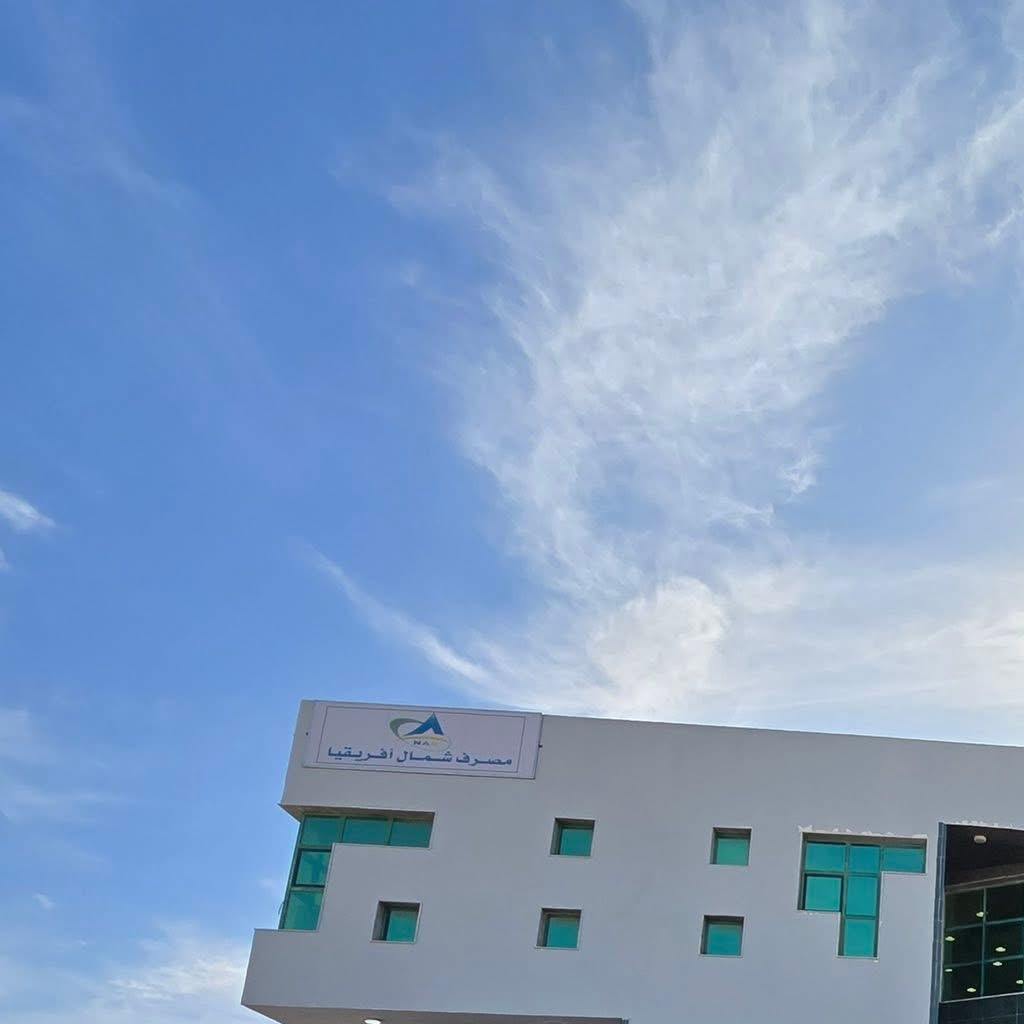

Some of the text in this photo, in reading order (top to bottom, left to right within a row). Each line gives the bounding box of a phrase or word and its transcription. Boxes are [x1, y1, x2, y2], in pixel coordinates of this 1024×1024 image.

[327, 746, 512, 766] مصرف شمال أفريقيا
